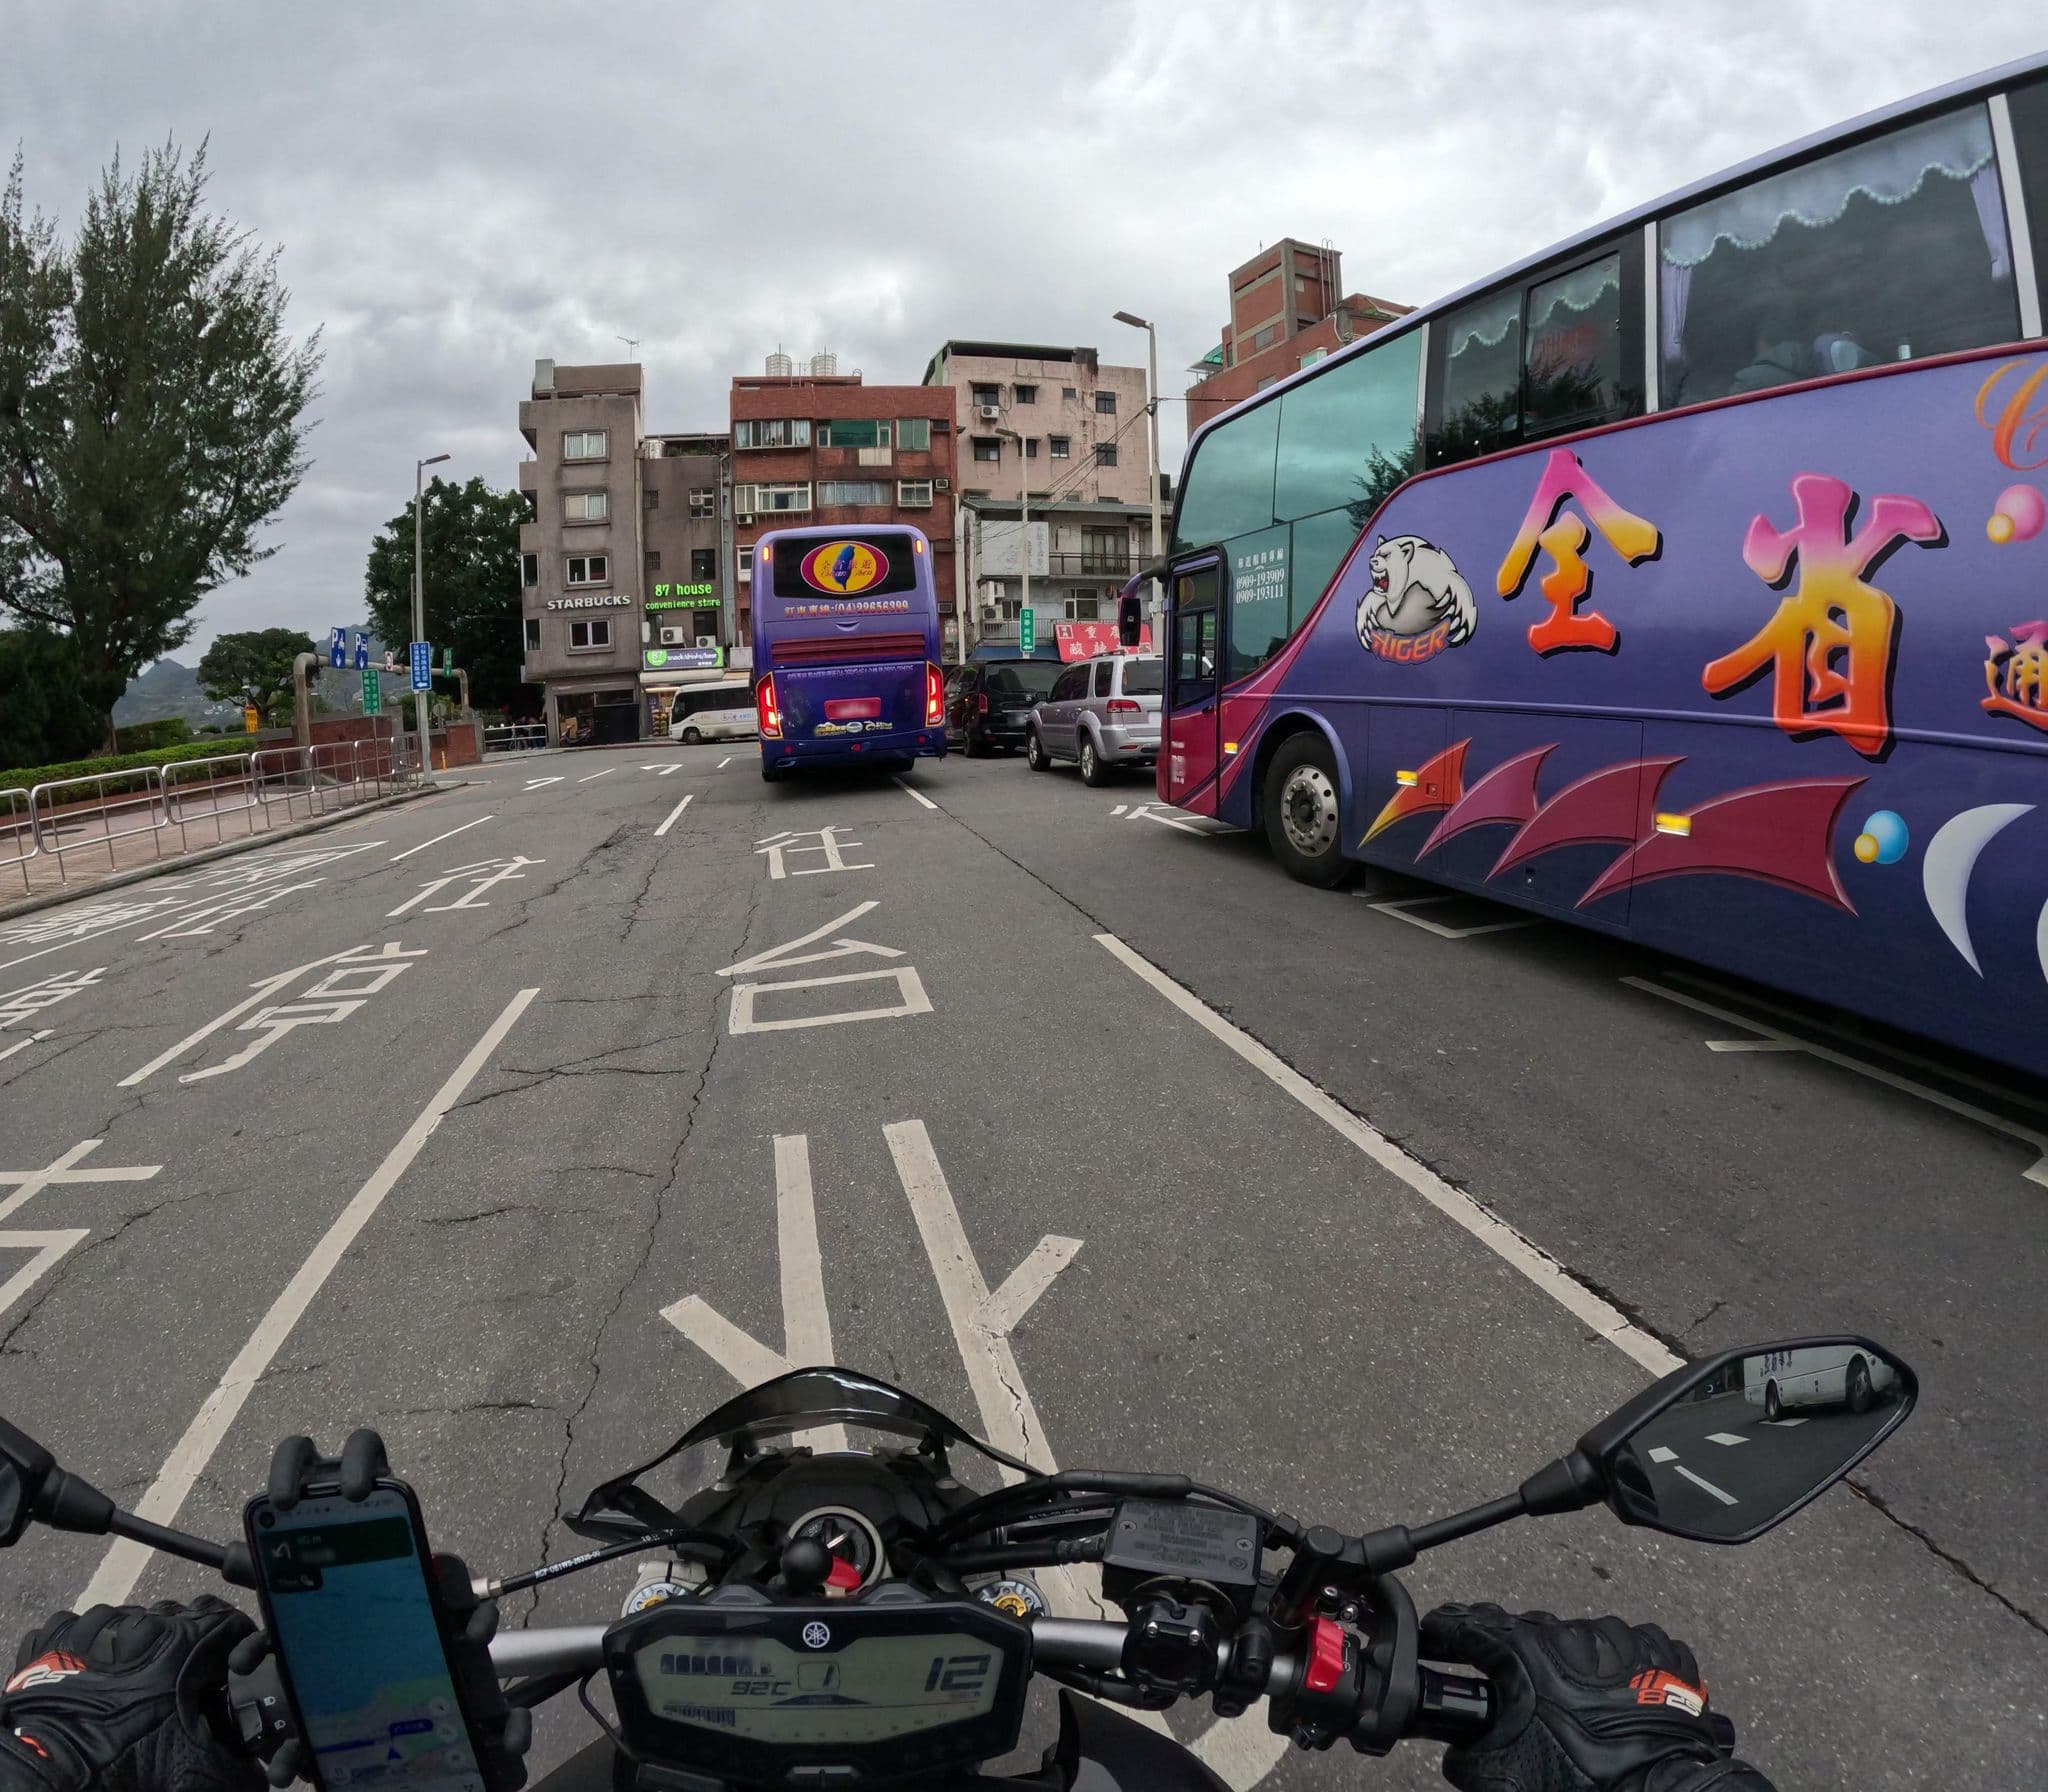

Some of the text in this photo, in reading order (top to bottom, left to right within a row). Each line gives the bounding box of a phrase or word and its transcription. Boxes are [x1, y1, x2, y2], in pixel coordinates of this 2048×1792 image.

[1236, 568, 1285, 590] 0909-193909
[654, 582, 713, 597] 87 house
[1236, 584, 1284, 605] 0909-193111
[547, 595, 631, 610] STARBUCKS
[645, 598, 721, 610] convenience store
[1497, 447, 1946, 758] 全省
[331, 628, 338, 648] P
[355, 633, 361, 651] P
[924, 1654, 992, 1692] 12
